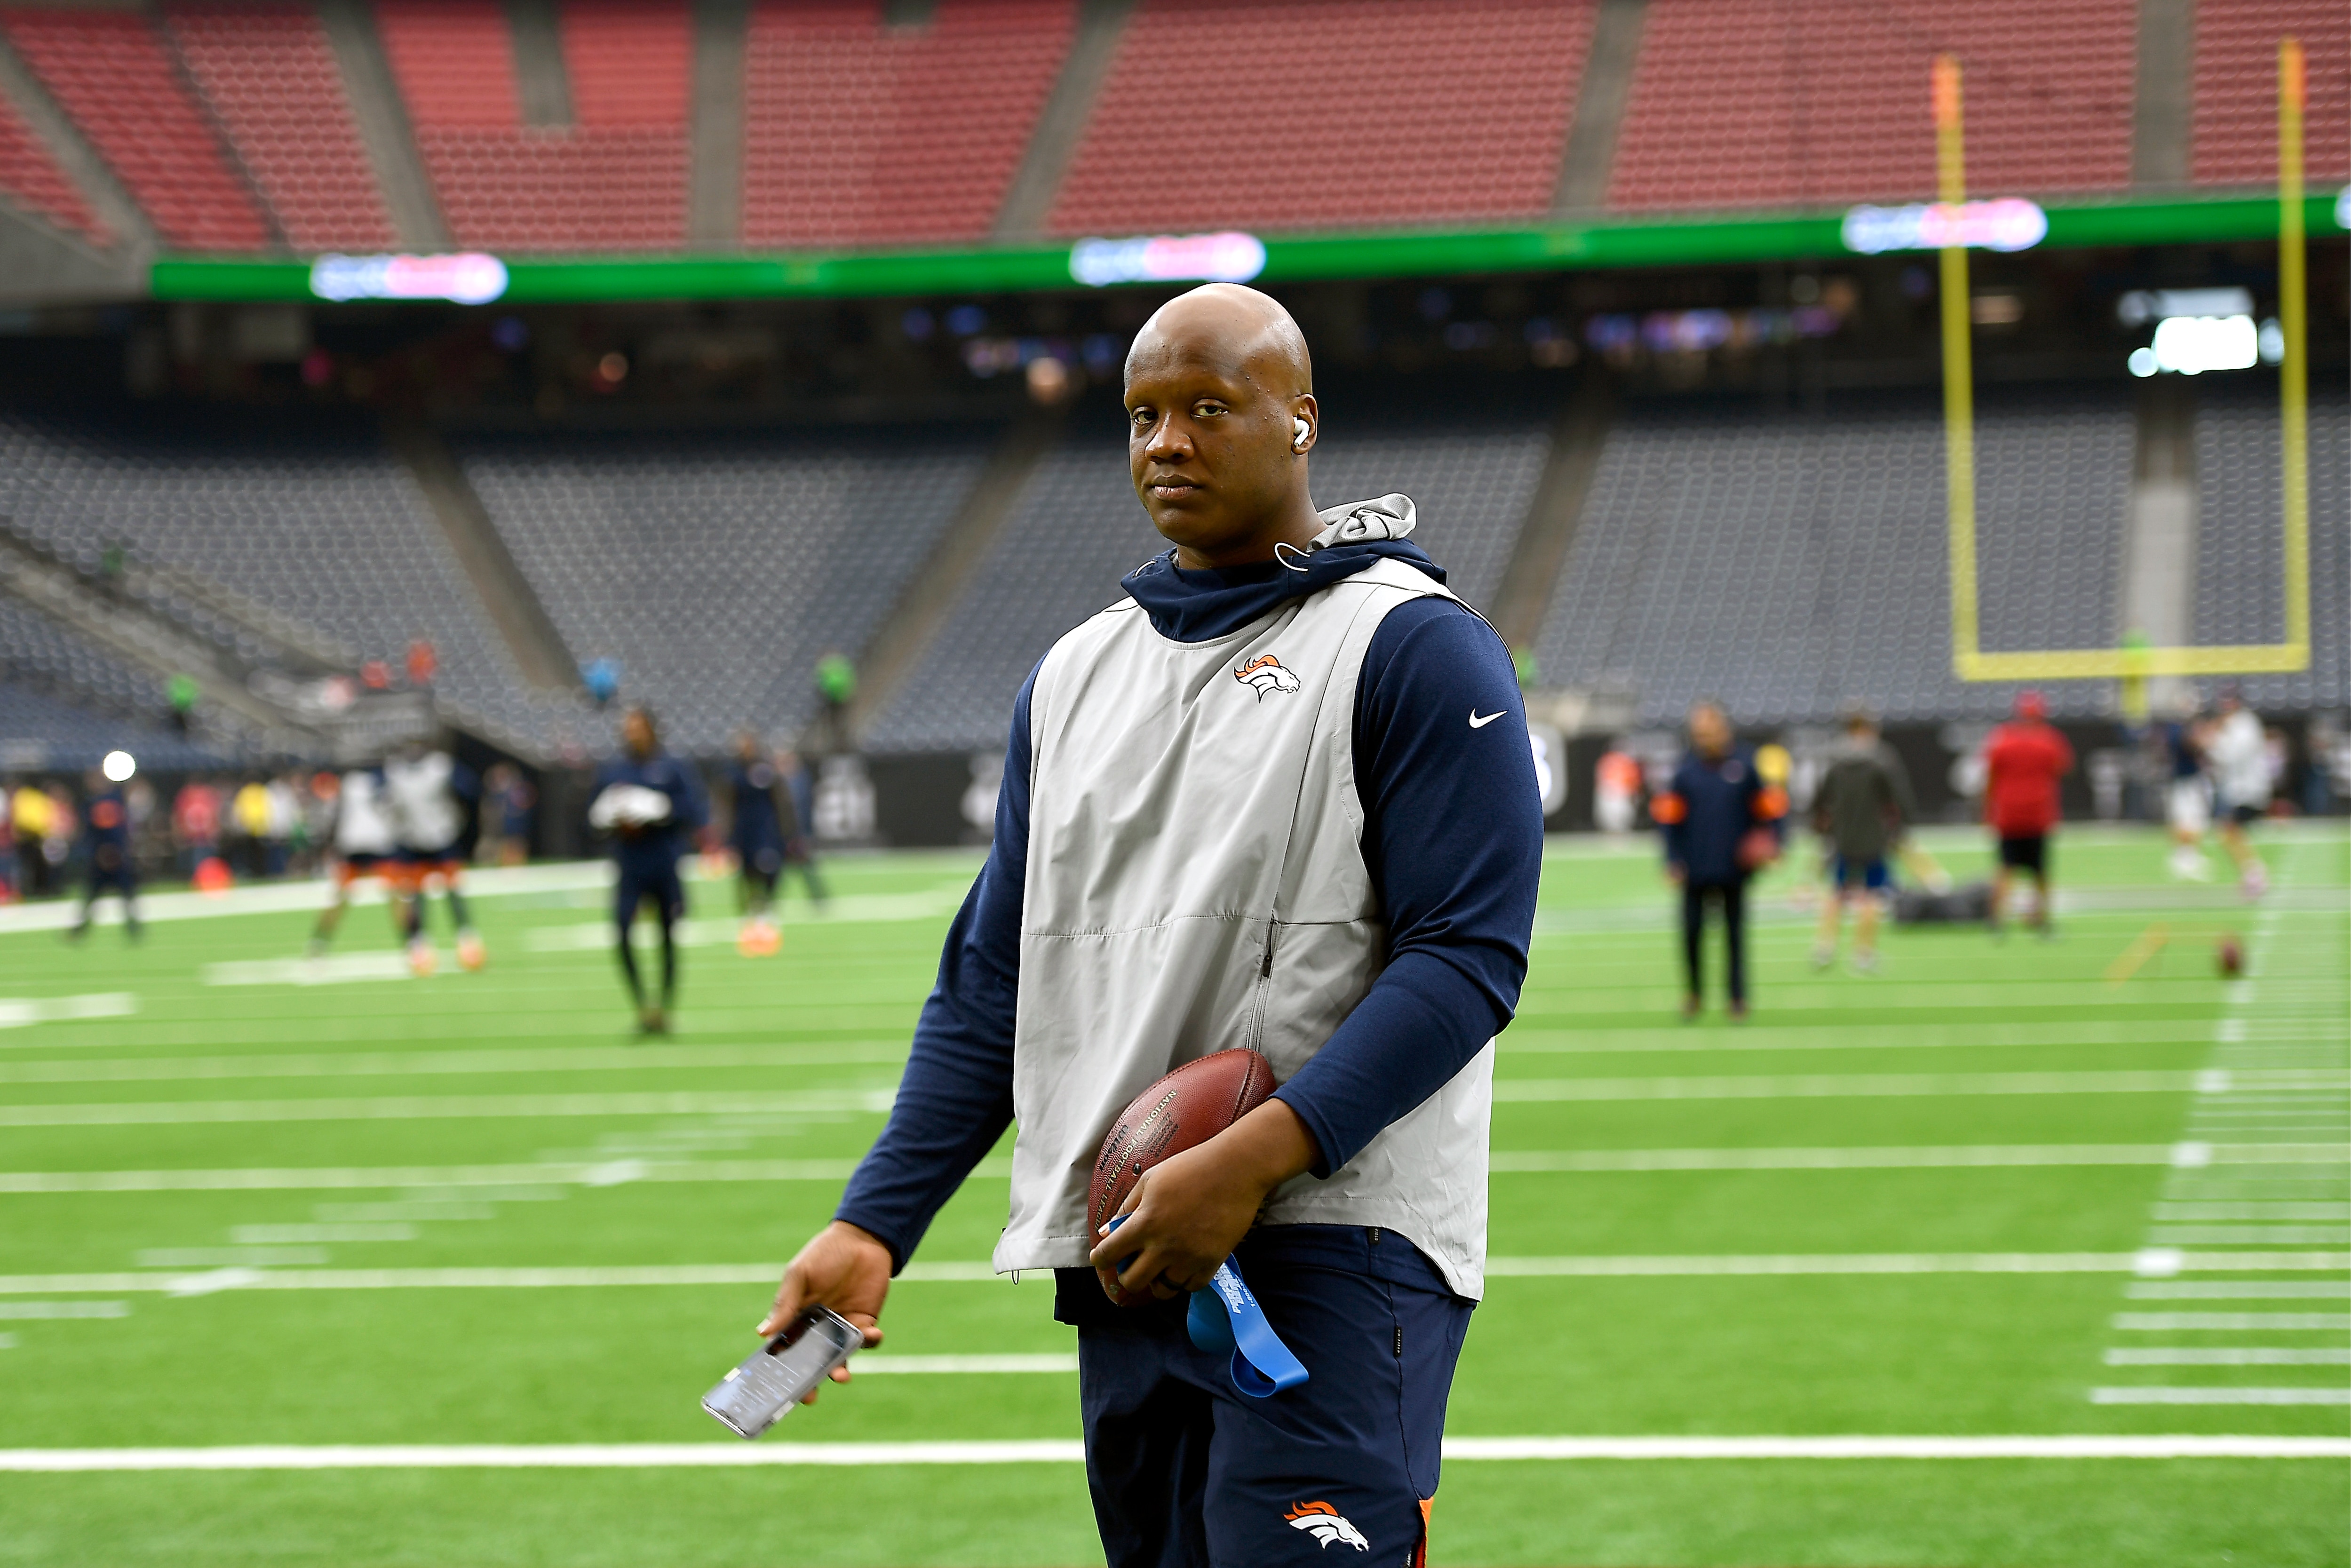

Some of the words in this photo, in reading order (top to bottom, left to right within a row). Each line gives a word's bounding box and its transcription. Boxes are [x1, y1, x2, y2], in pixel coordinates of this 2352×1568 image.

[1136, 1090, 1176, 1136] NATIONAL
[1105, 1138, 1137, 1190] FOOTBALL
[1214, 1270, 1241, 1314] PERFOR
